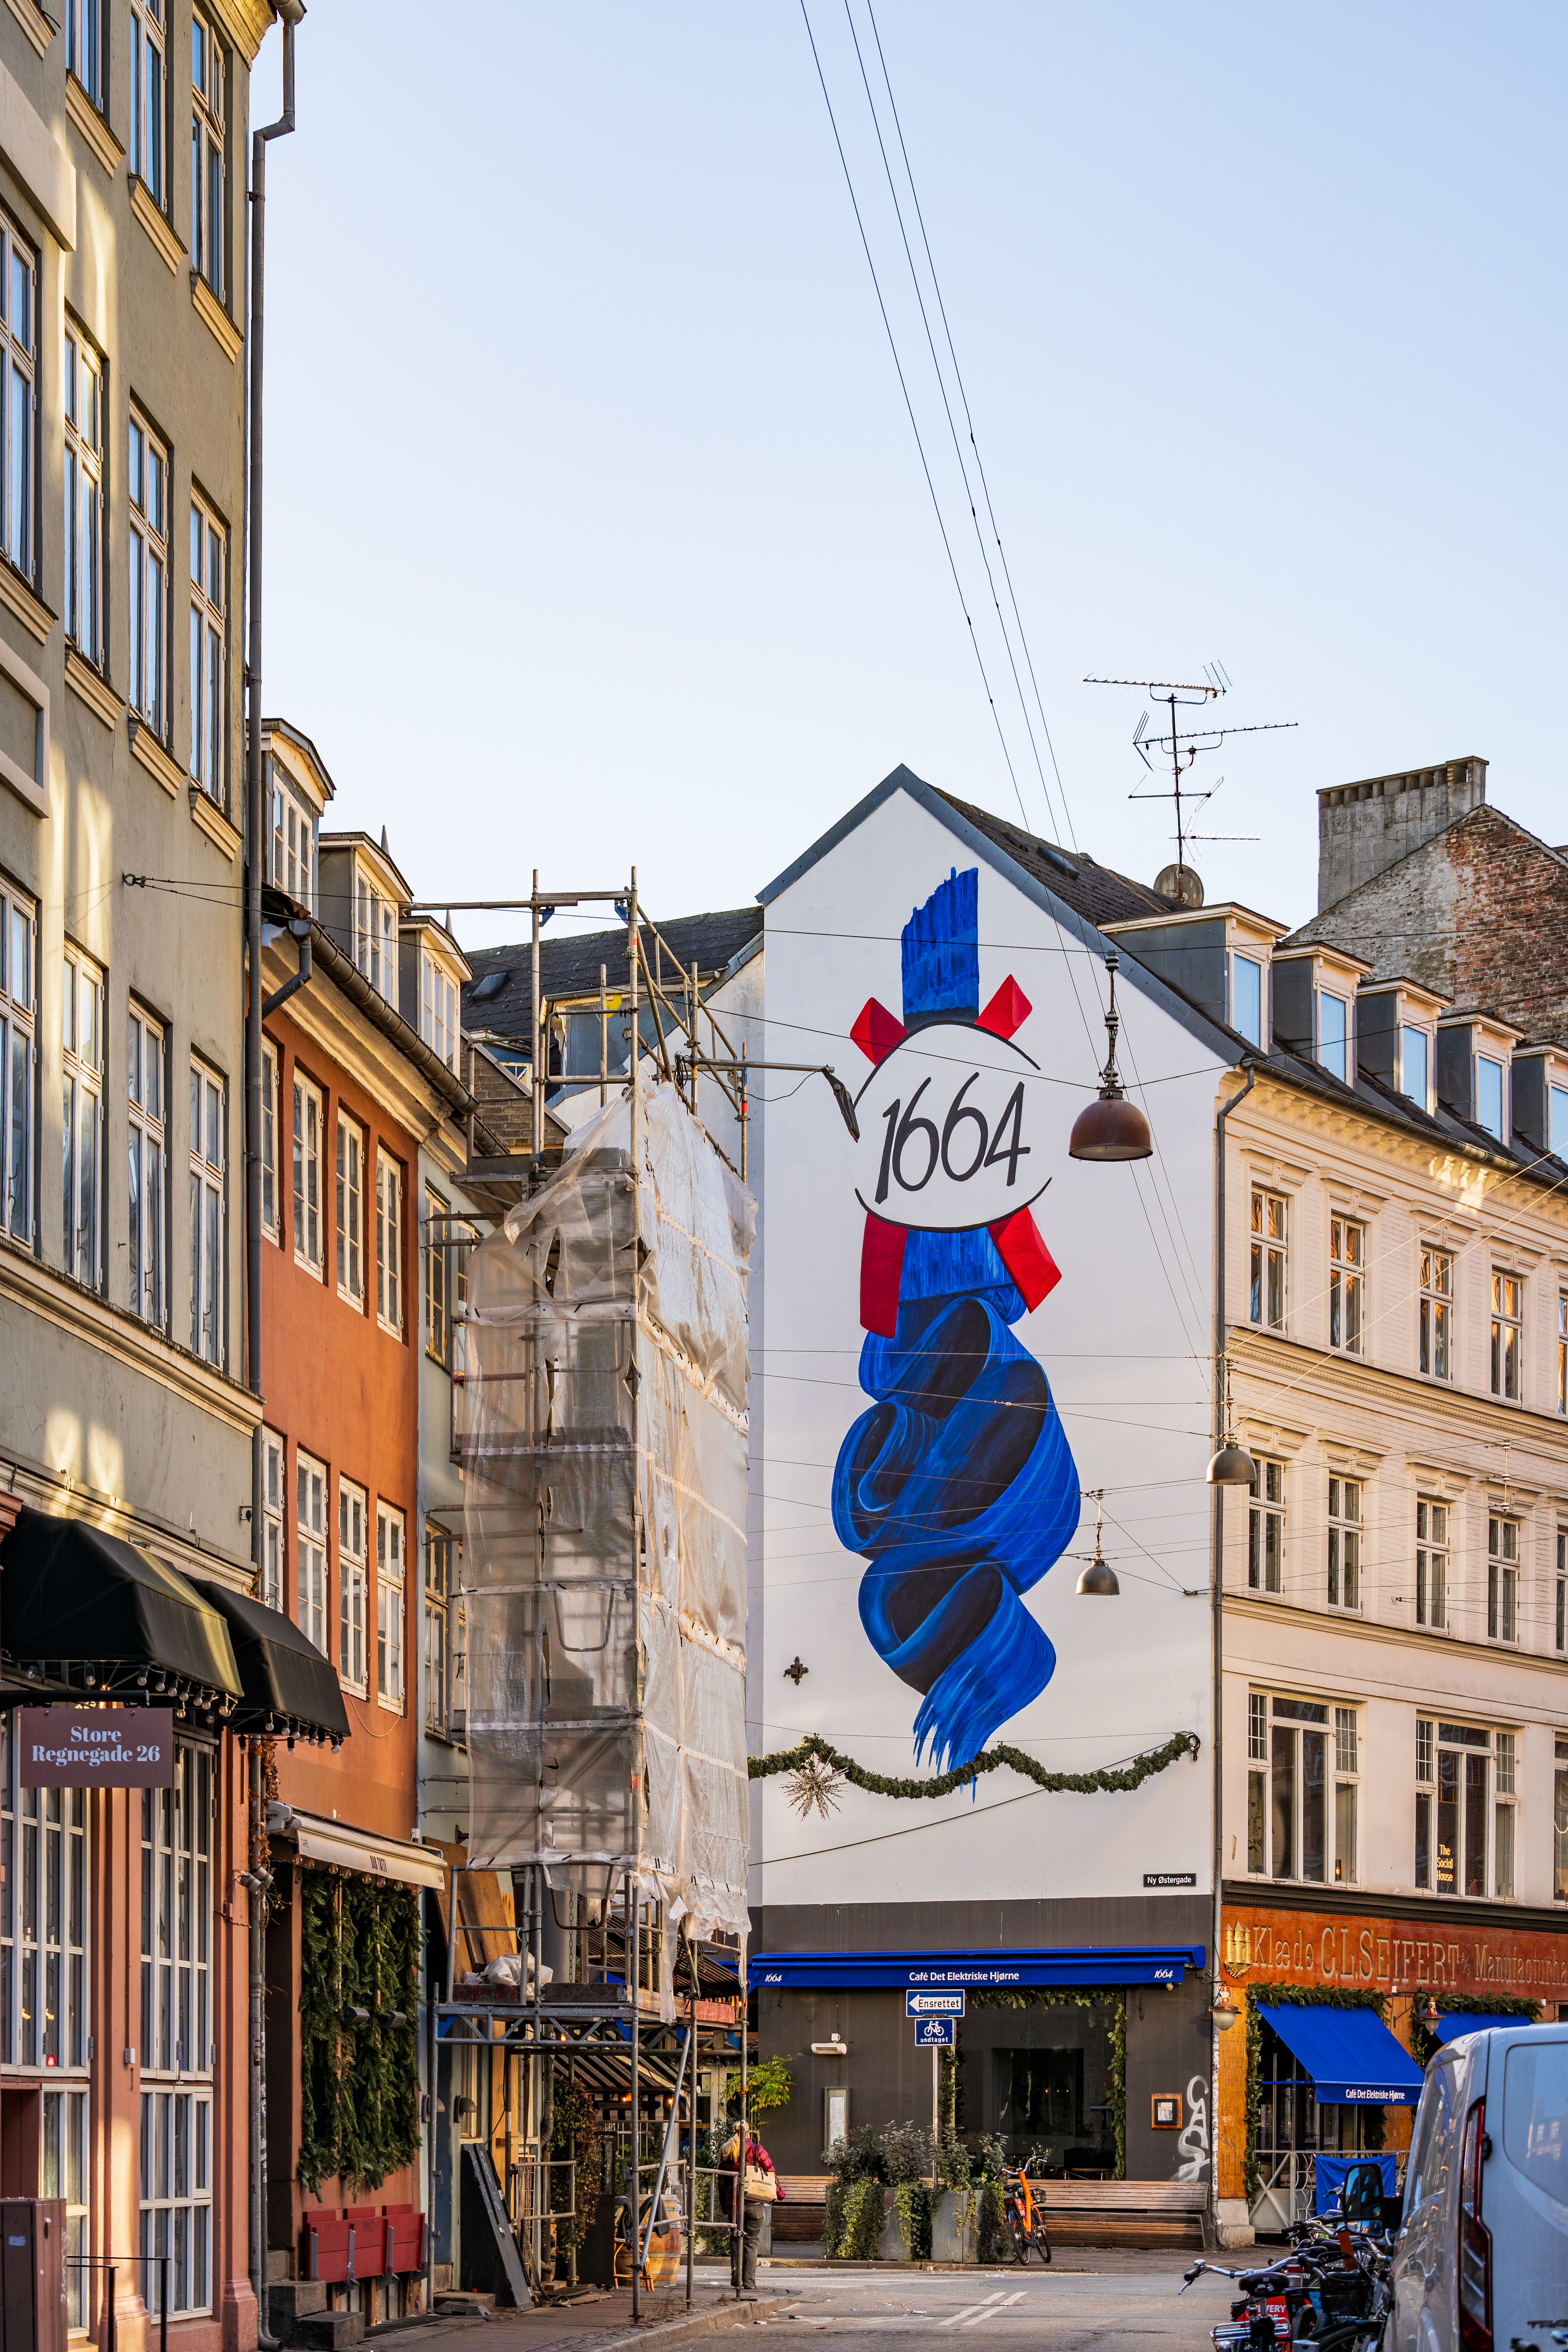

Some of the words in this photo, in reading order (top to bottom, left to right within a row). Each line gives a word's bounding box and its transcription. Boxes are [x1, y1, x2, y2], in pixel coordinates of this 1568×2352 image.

[875, 1072, 1031, 1204] 1664
[71, 1726, 121, 1742] Store
[32, 1745, 133, 1767] Regnegade
[137, 1746, 160, 1762] 26
[1439, 1844, 1450, 1856] The
[1437, 1857, 1453, 1869] Social
[1147, 1876, 1156, 1885] Ny
[1158, 1876, 1191, 1884] Østergade
[1436, 1870, 1453, 1882] House
[1253, 1925, 1314, 1971] Klæde
[765, 1973, 782, 1982] 1664
[909, 1972, 928, 1980] Café
[930, 1972, 945, 1981] Det
[947, 1972, 988, 1980] Elektriske
[990, 1972, 1019, 1982] Hjørne
[1154, 1969, 1173, 1978] 1664
[919, 1999, 959, 2007] Ensrettet
[1346, 2089, 1356, 2098] Café
[1357, 2089, 1366, 2098] Det
[1367, 2090, 1388, 2099] Elektriske
[1389, 2090, 1405, 2102] Hjørne
